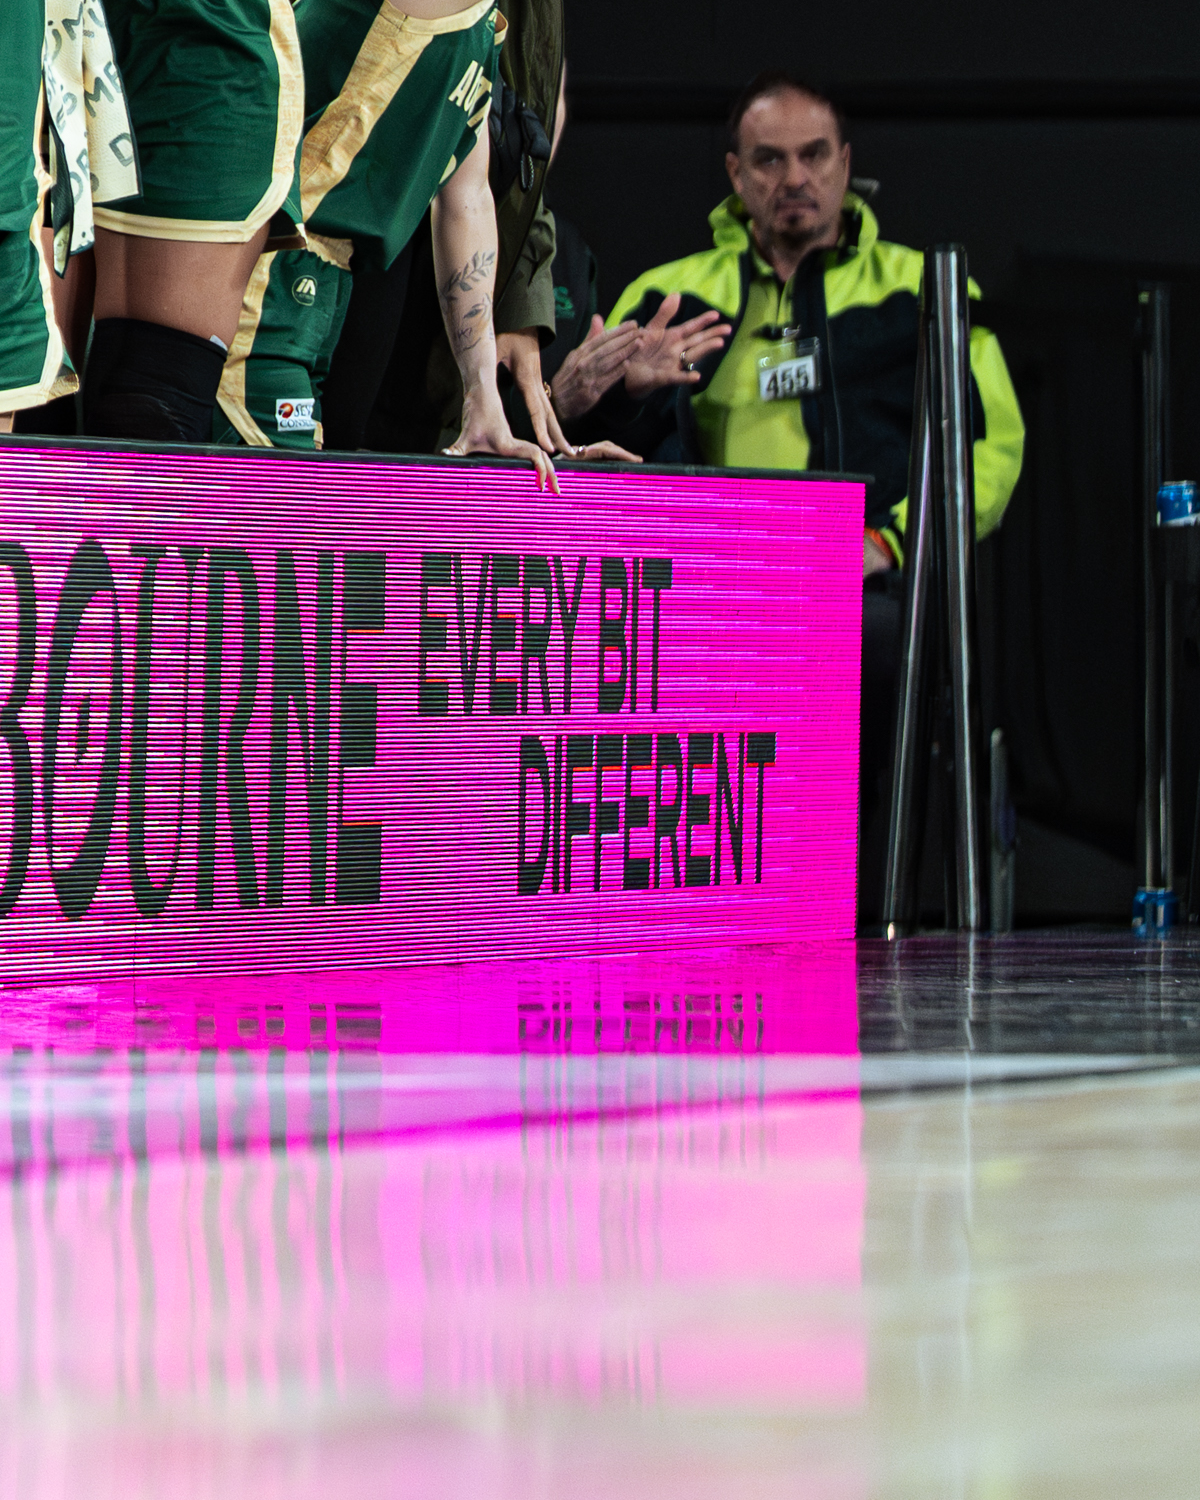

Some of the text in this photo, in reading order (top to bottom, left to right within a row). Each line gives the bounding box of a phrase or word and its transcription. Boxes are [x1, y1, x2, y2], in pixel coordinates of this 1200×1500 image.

[766, 365, 810, 399] 455
[417, 552, 673, 717] EVERY BIT
[517, 731, 777, 896] DIFFERENT
